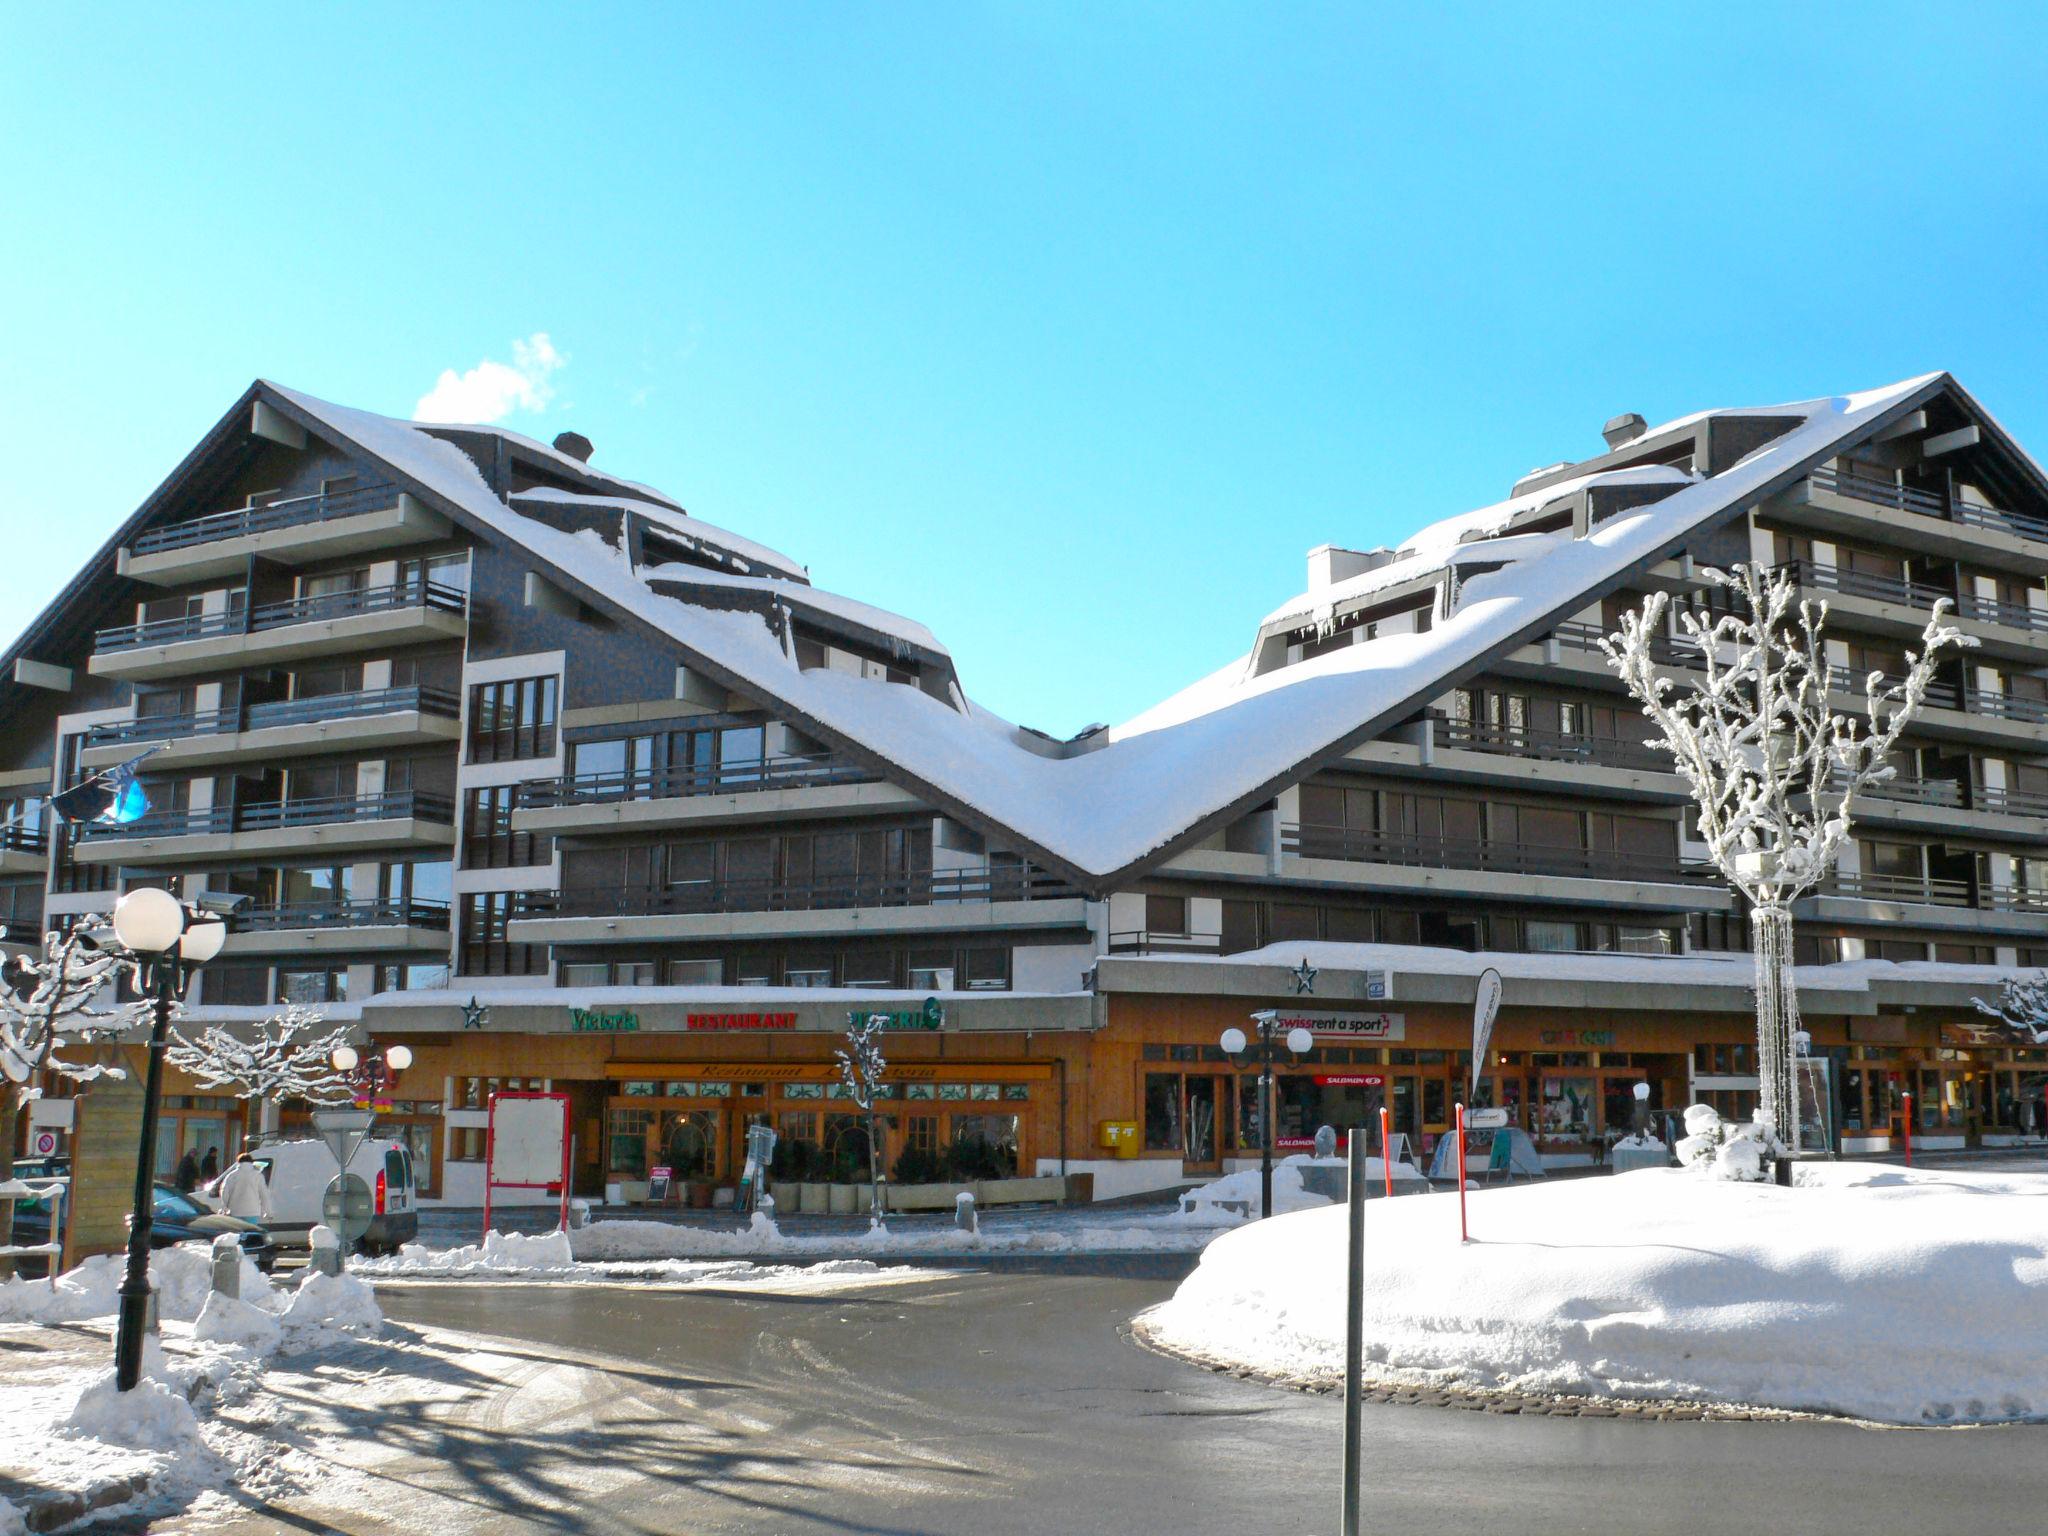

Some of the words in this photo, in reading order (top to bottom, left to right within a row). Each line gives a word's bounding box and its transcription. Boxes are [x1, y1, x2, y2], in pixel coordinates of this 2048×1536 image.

[569, 1008, 638, 1031] Victoria
[687, 1013, 798, 1029] RESTAURANT
[1338, 1021, 1347, 1030] a
[1349, 1018, 1381, 1032] sport
[702, 1066, 803, 1077] Restaurant
